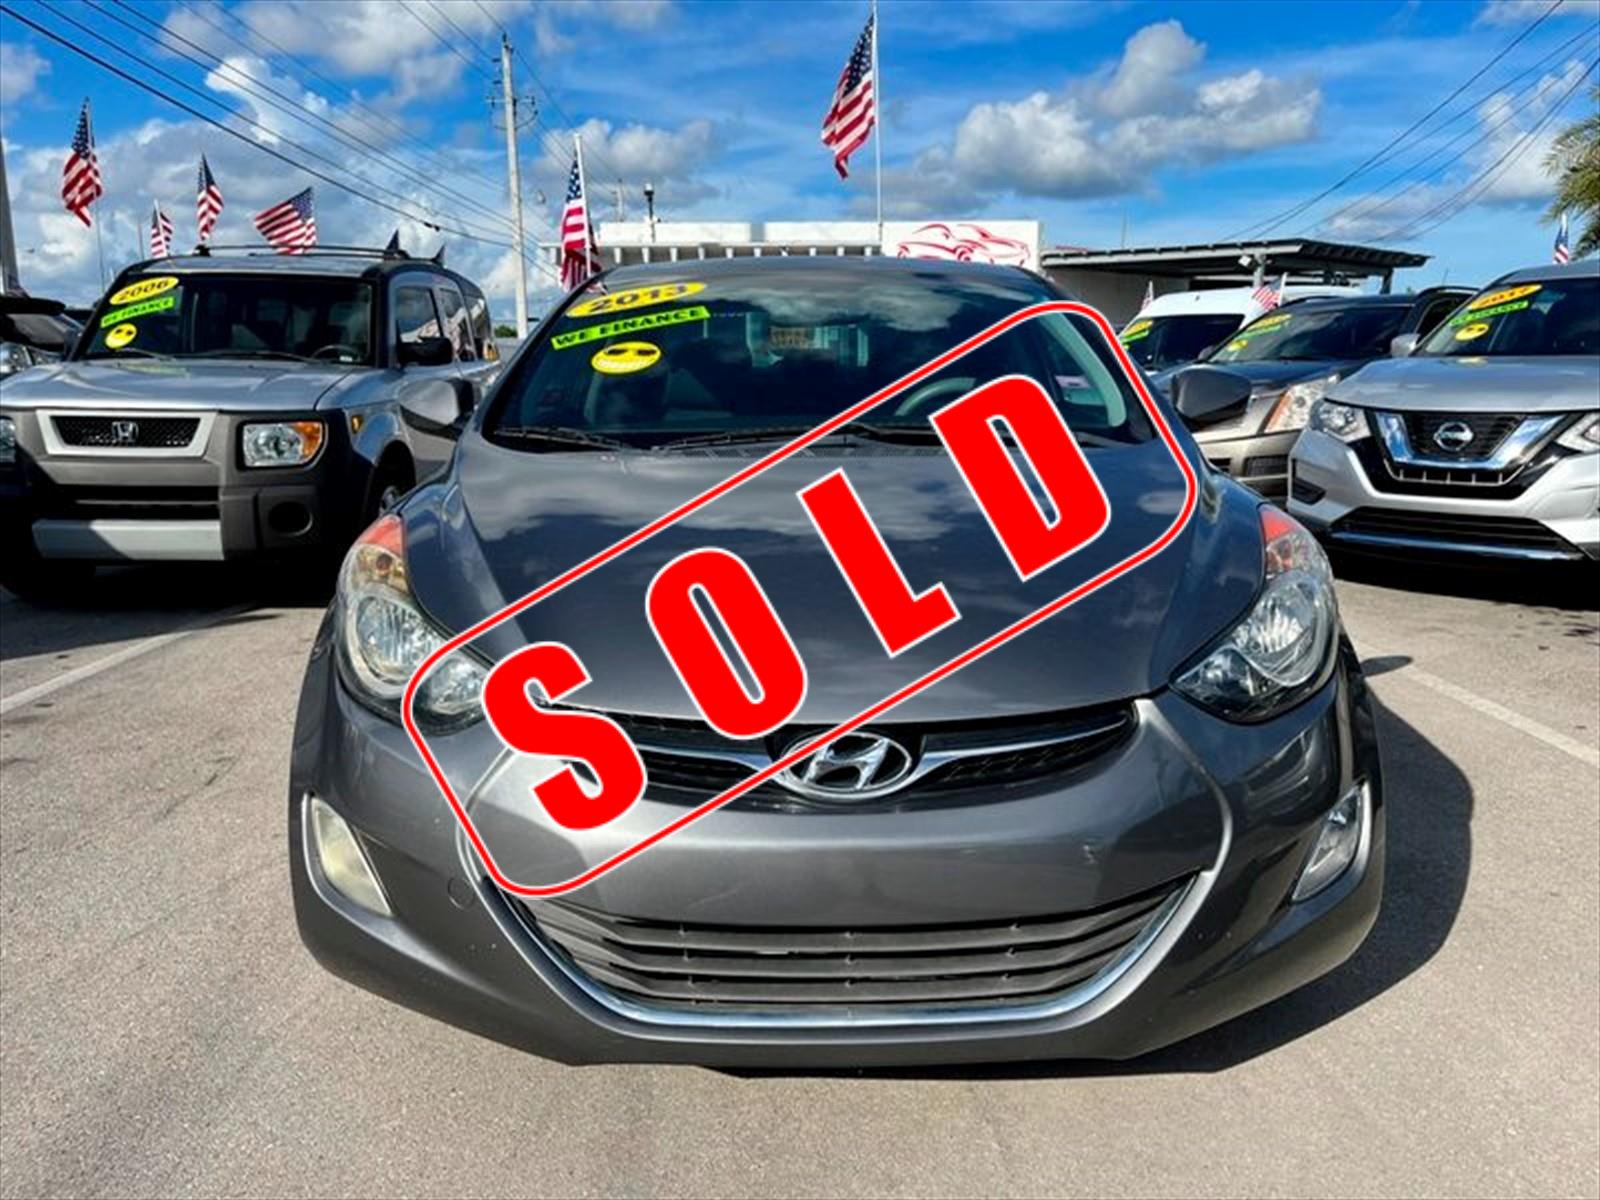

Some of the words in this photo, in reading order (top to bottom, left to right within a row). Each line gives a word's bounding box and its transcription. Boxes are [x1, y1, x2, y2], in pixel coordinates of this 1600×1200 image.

[117, 281, 169, 302] 2006
[589, 285, 688, 313] 2013
[556, 330, 590, 346] WE
[600, 308, 701, 336] FINANCE
